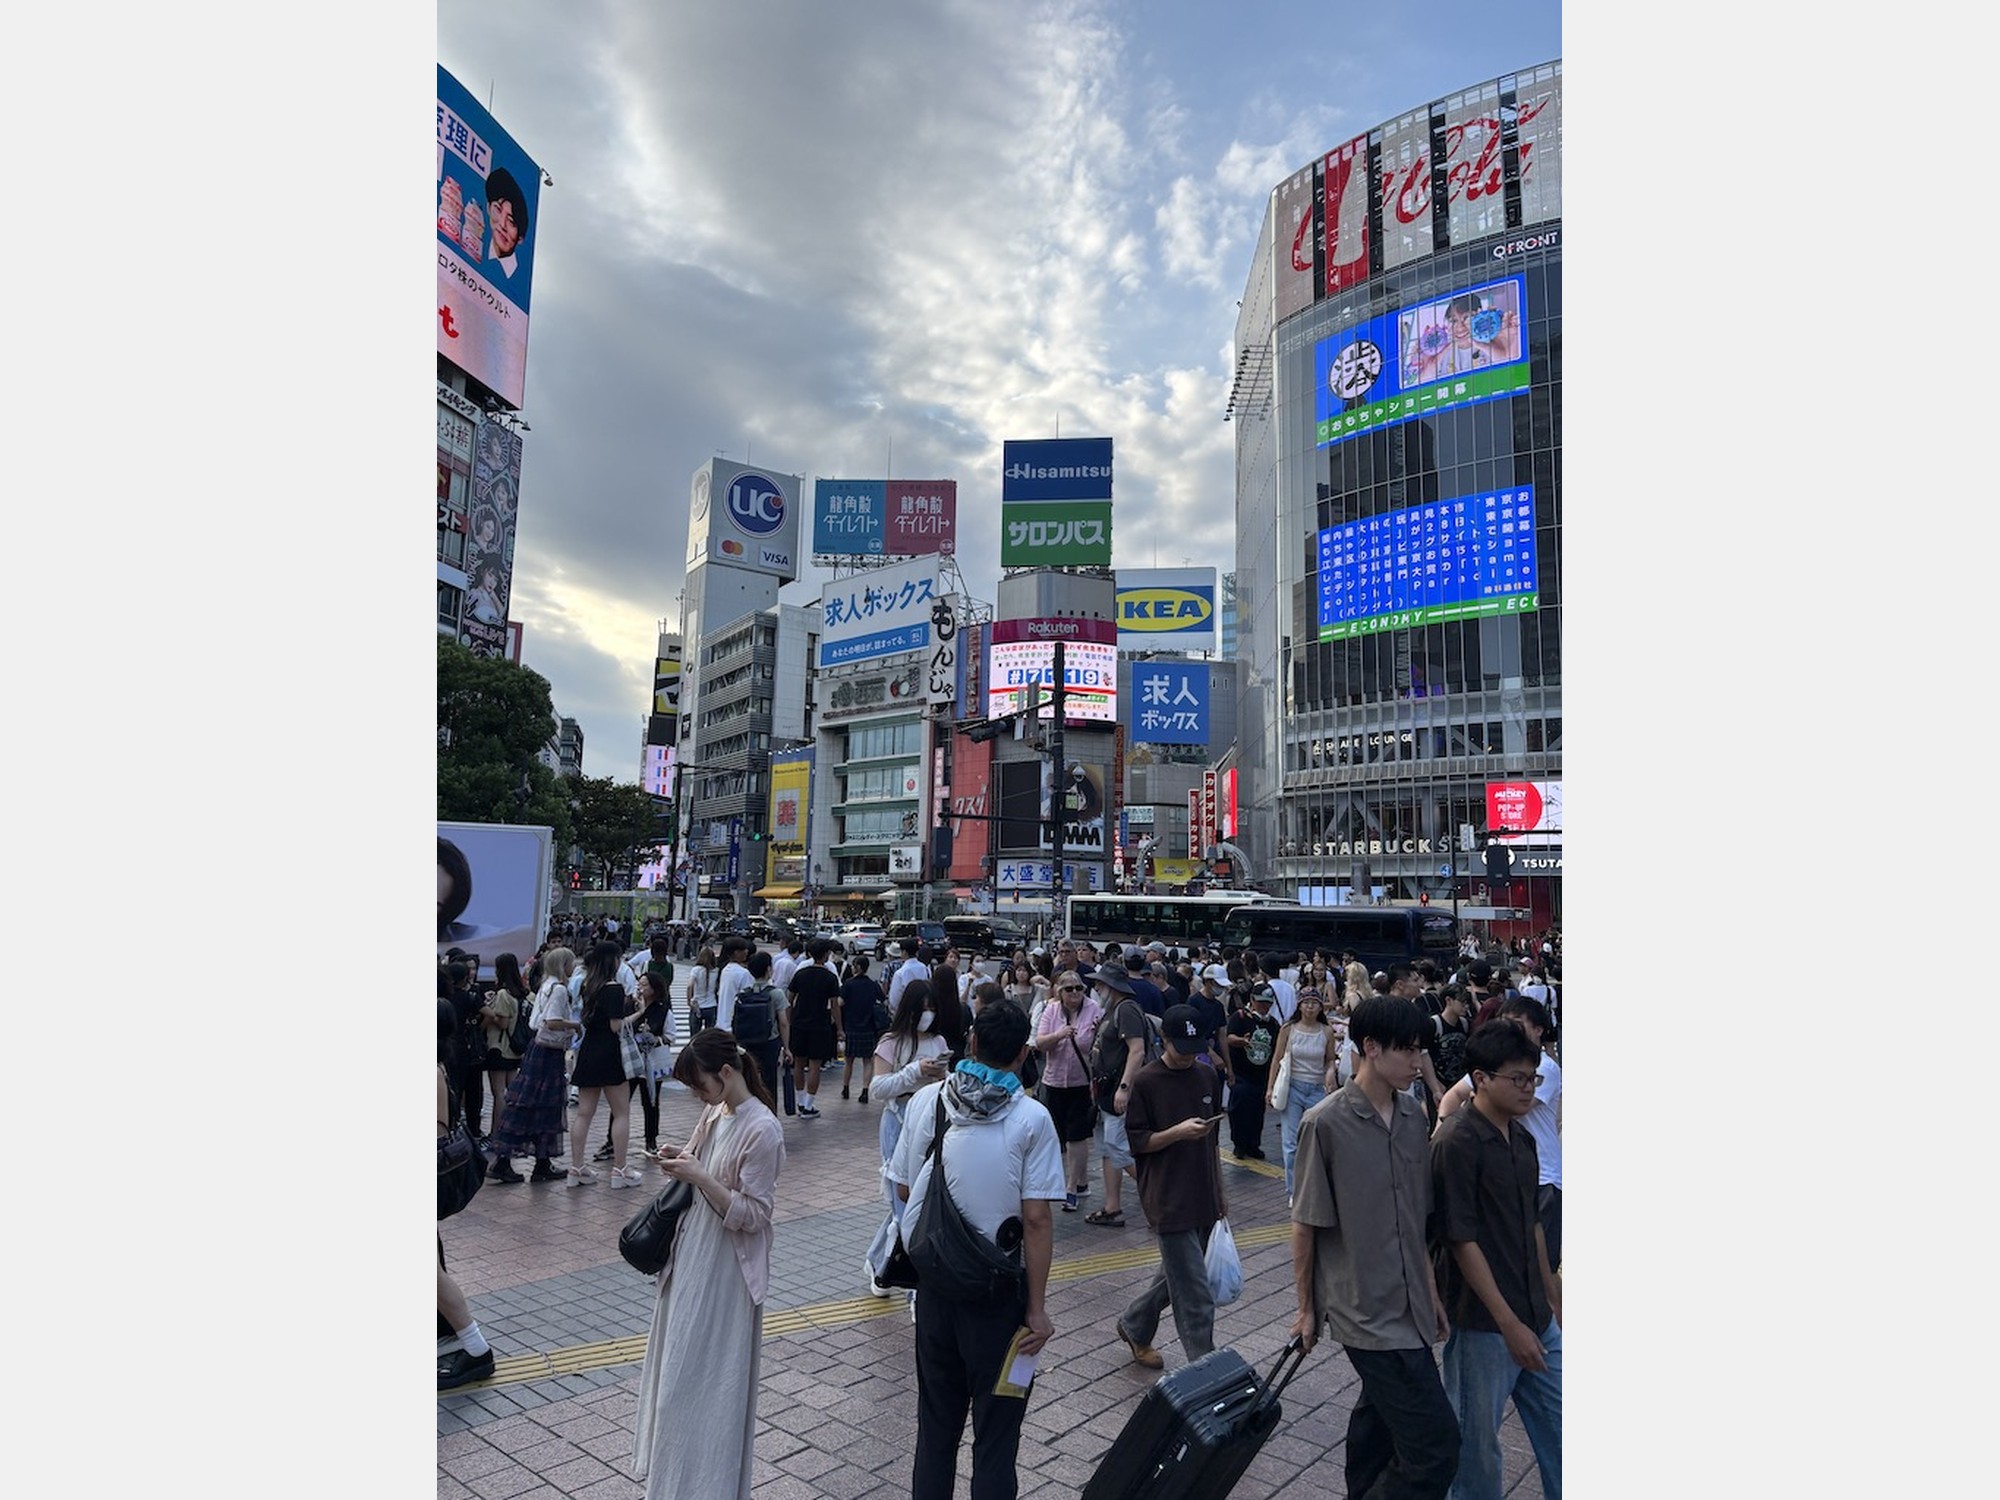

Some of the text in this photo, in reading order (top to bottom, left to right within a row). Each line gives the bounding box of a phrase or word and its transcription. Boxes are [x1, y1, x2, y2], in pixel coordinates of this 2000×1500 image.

[1493, 232, 1557, 260] QFRONT
[1005, 463, 1111, 479] Hisamitsu
[733, 485, 781, 522] UC
[829, 495, 872, 514] 龍角散
[901, 495, 944, 514] 龍角散
[1008, 520, 1105, 546] サロンパス
[763, 551, 788, 566] VISA
[825, 578, 935, 628] 求人ボックス
[1027, 622, 1079, 634] Rakuten
[1350, 611, 1423, 634] ECONOMY
[929, 598, 956, 699] もんじゃ
[1141, 674, 1199, 706] 求人
[1141, 709, 1199, 731] ボックス
[1190, 824, 1199, 860] カラオ
[1312, 835, 1449, 856] STARBUCKS
[1522, 858, 1562, 869] TSUTA
